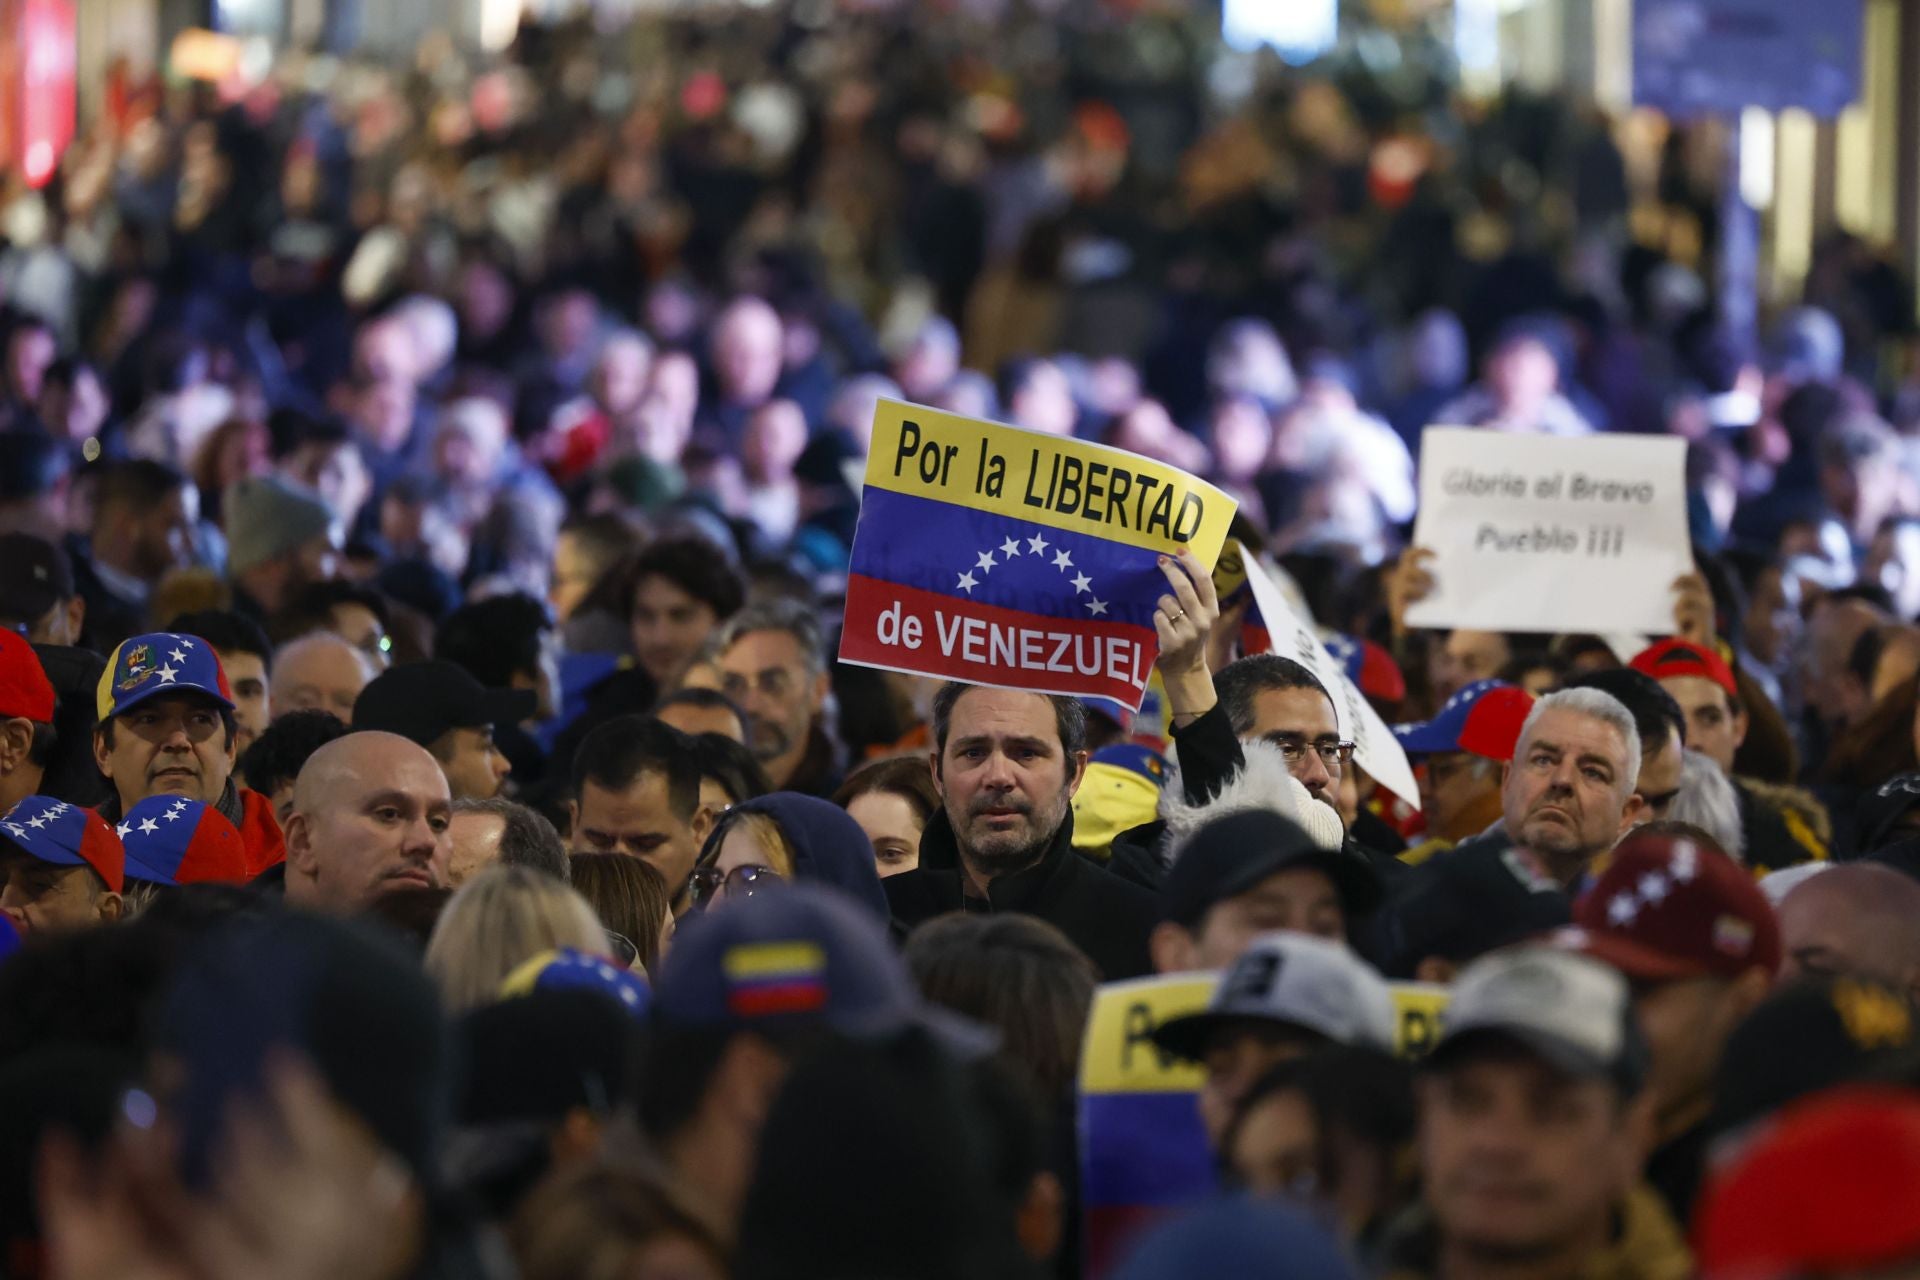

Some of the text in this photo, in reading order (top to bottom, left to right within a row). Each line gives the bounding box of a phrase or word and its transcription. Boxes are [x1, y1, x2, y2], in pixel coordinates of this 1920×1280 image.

[894, 420, 1204, 544] Por la LIBERTAD
[1442, 466, 1655, 503] Gloria al Bravo
[1475, 522, 1578, 553] Pueblo
[876, 600, 923, 650] de
